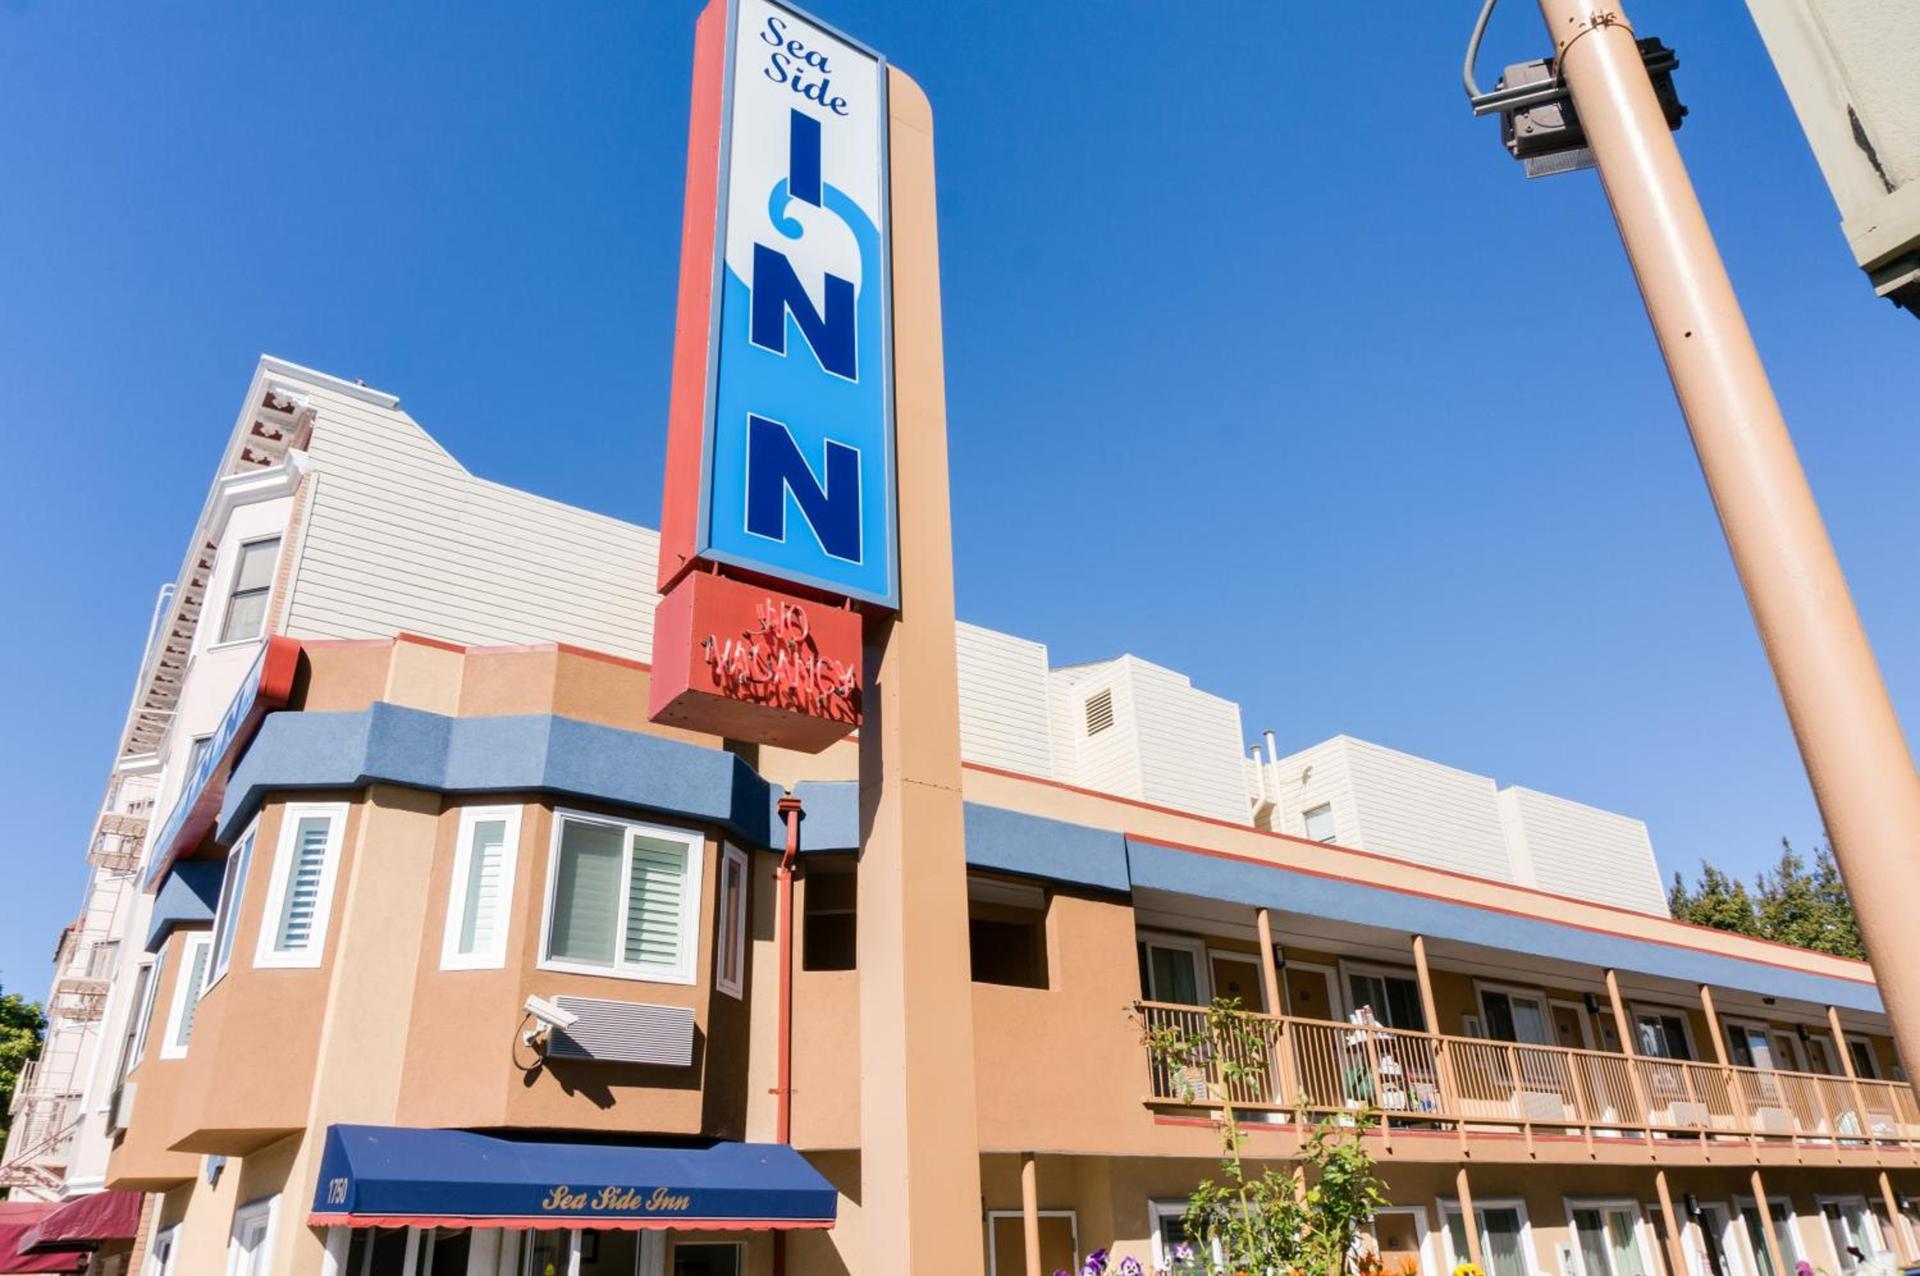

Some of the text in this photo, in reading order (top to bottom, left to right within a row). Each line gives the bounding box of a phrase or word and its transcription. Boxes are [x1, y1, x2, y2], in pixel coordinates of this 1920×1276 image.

[760, 16, 832, 74] Sea
[764, 52, 849, 117] Side
[745, 106, 864, 566] INN
[327, 1177, 349, 1205] 1750
[542, 1185, 691, 1211] Sea Side Inn
